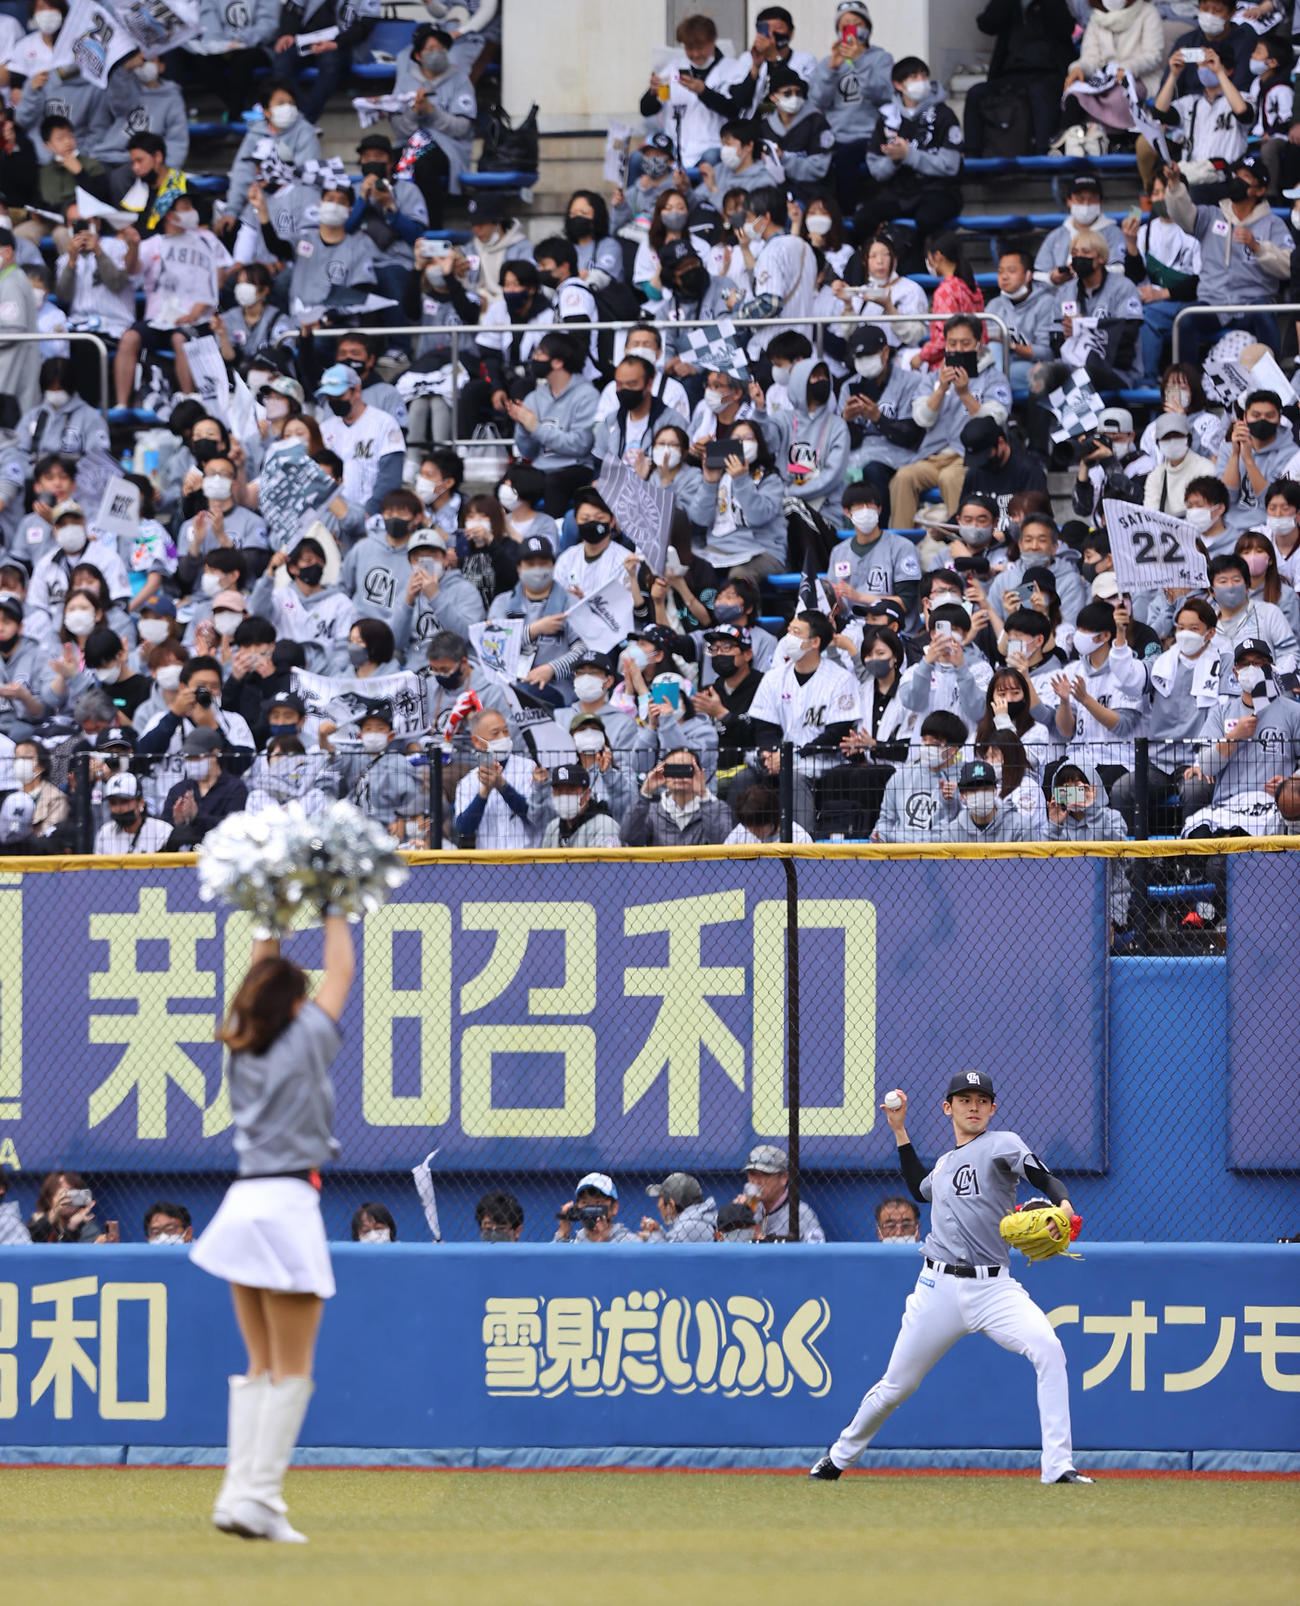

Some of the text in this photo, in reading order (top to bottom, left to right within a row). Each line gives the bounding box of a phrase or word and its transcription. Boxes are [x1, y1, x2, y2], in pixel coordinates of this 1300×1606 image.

[1132, 531, 1185, 563] 22
[0, 1275, 167, 1420] 和
[483, 1288, 831, 1398] 雪見だいふく
[1046, 1300, 1300, 1392] オンモ
